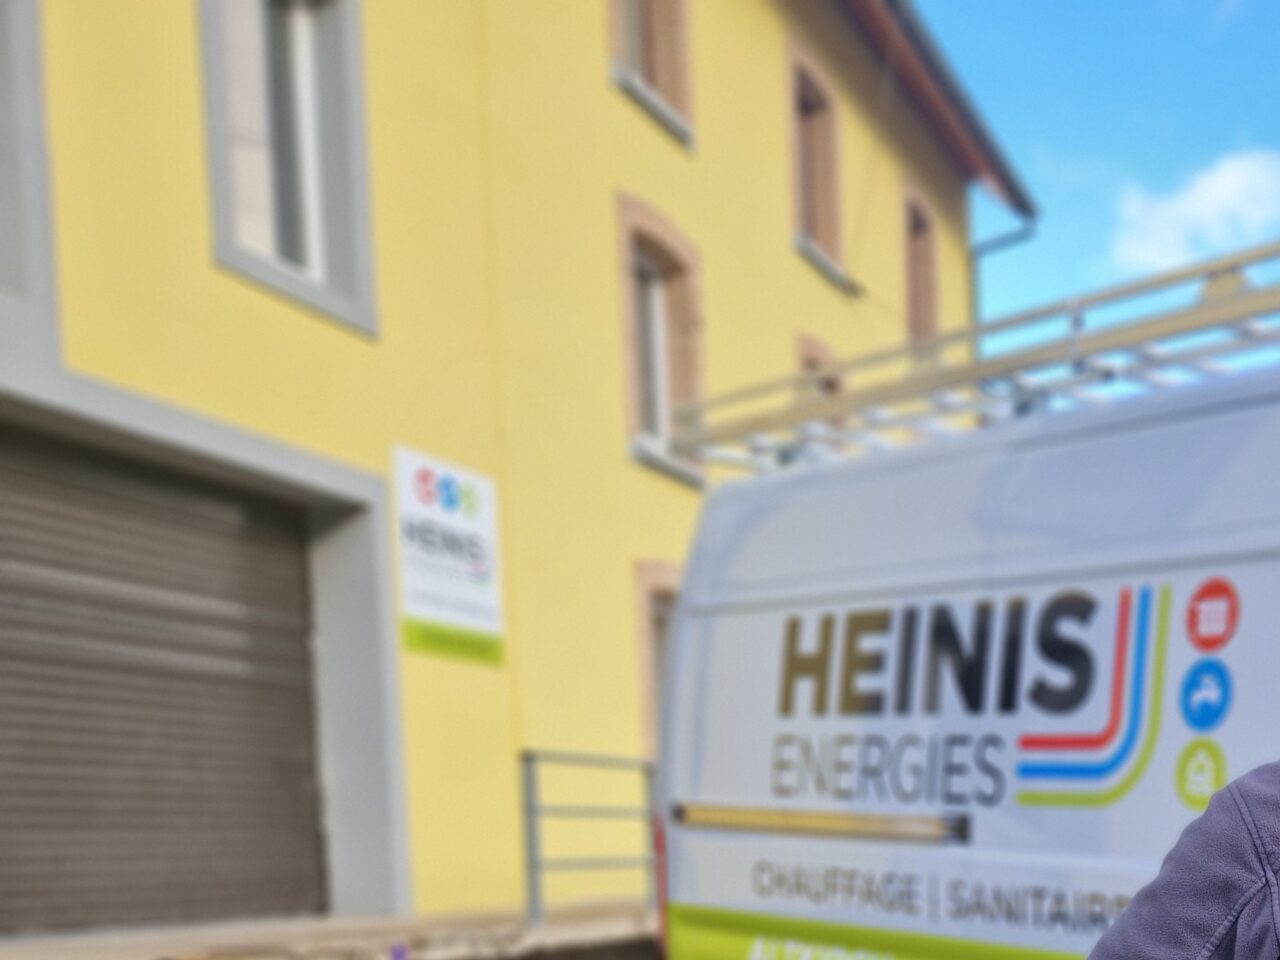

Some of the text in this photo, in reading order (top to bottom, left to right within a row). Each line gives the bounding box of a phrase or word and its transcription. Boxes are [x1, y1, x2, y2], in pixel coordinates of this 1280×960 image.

[778, 589, 1097, 716] HEINIS
[770, 732, 1006, 806] ENERGIES
[752, 861, 921, 915] CHAUFFAGE
